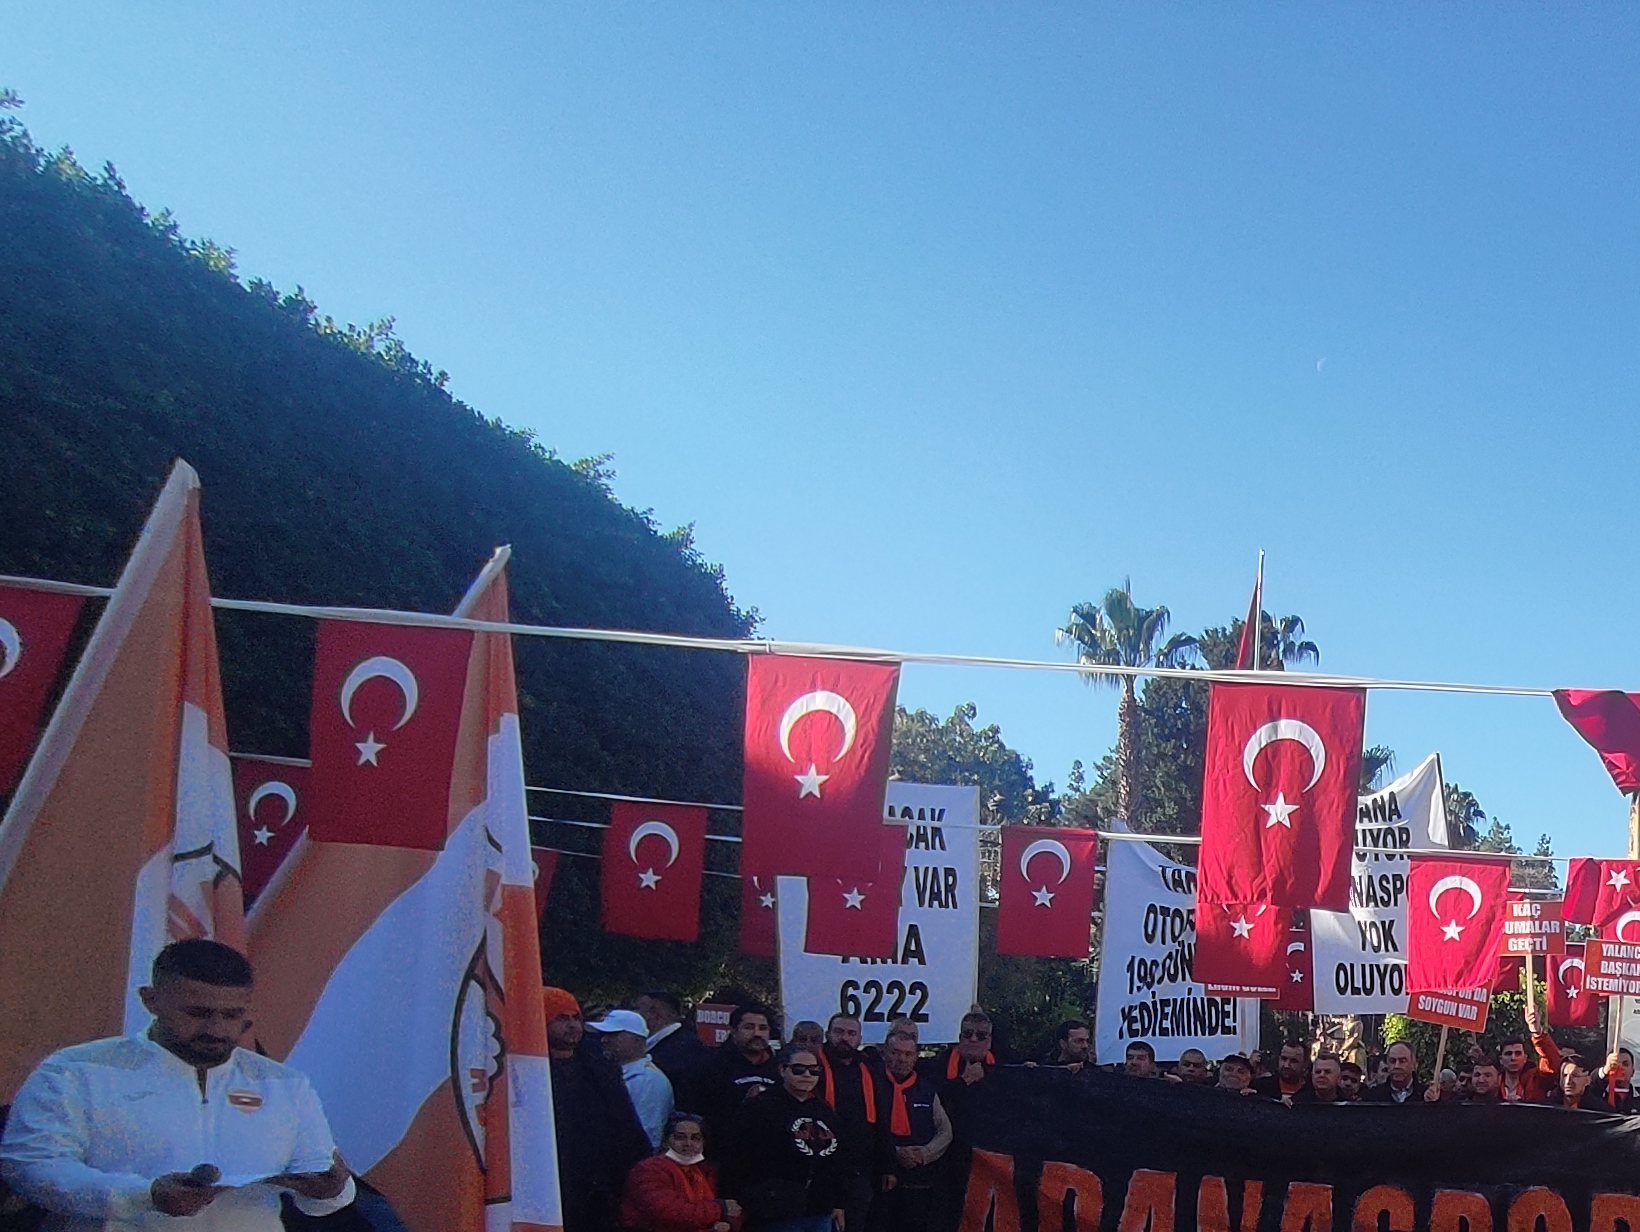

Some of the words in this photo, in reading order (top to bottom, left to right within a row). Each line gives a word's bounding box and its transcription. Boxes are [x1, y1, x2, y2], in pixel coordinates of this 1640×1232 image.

[913, 866, 958, 909] VAR
[1502, 920, 1560, 935] UMALAR
[1512, 903, 1541, 918] KAÇ
[1357, 918, 1399, 954] YOK
[1507, 937, 1548, 953] GEÇTİ
[1335, 962, 1409, 996] OLUYO
[841, 979, 929, 1023] 6222
[1118, 988, 1238, 1040] YEDİEMİNDE!
[1418, 995, 1457, 1016] SOYGUN
[1458, 1006, 1478, 1021] VAR
